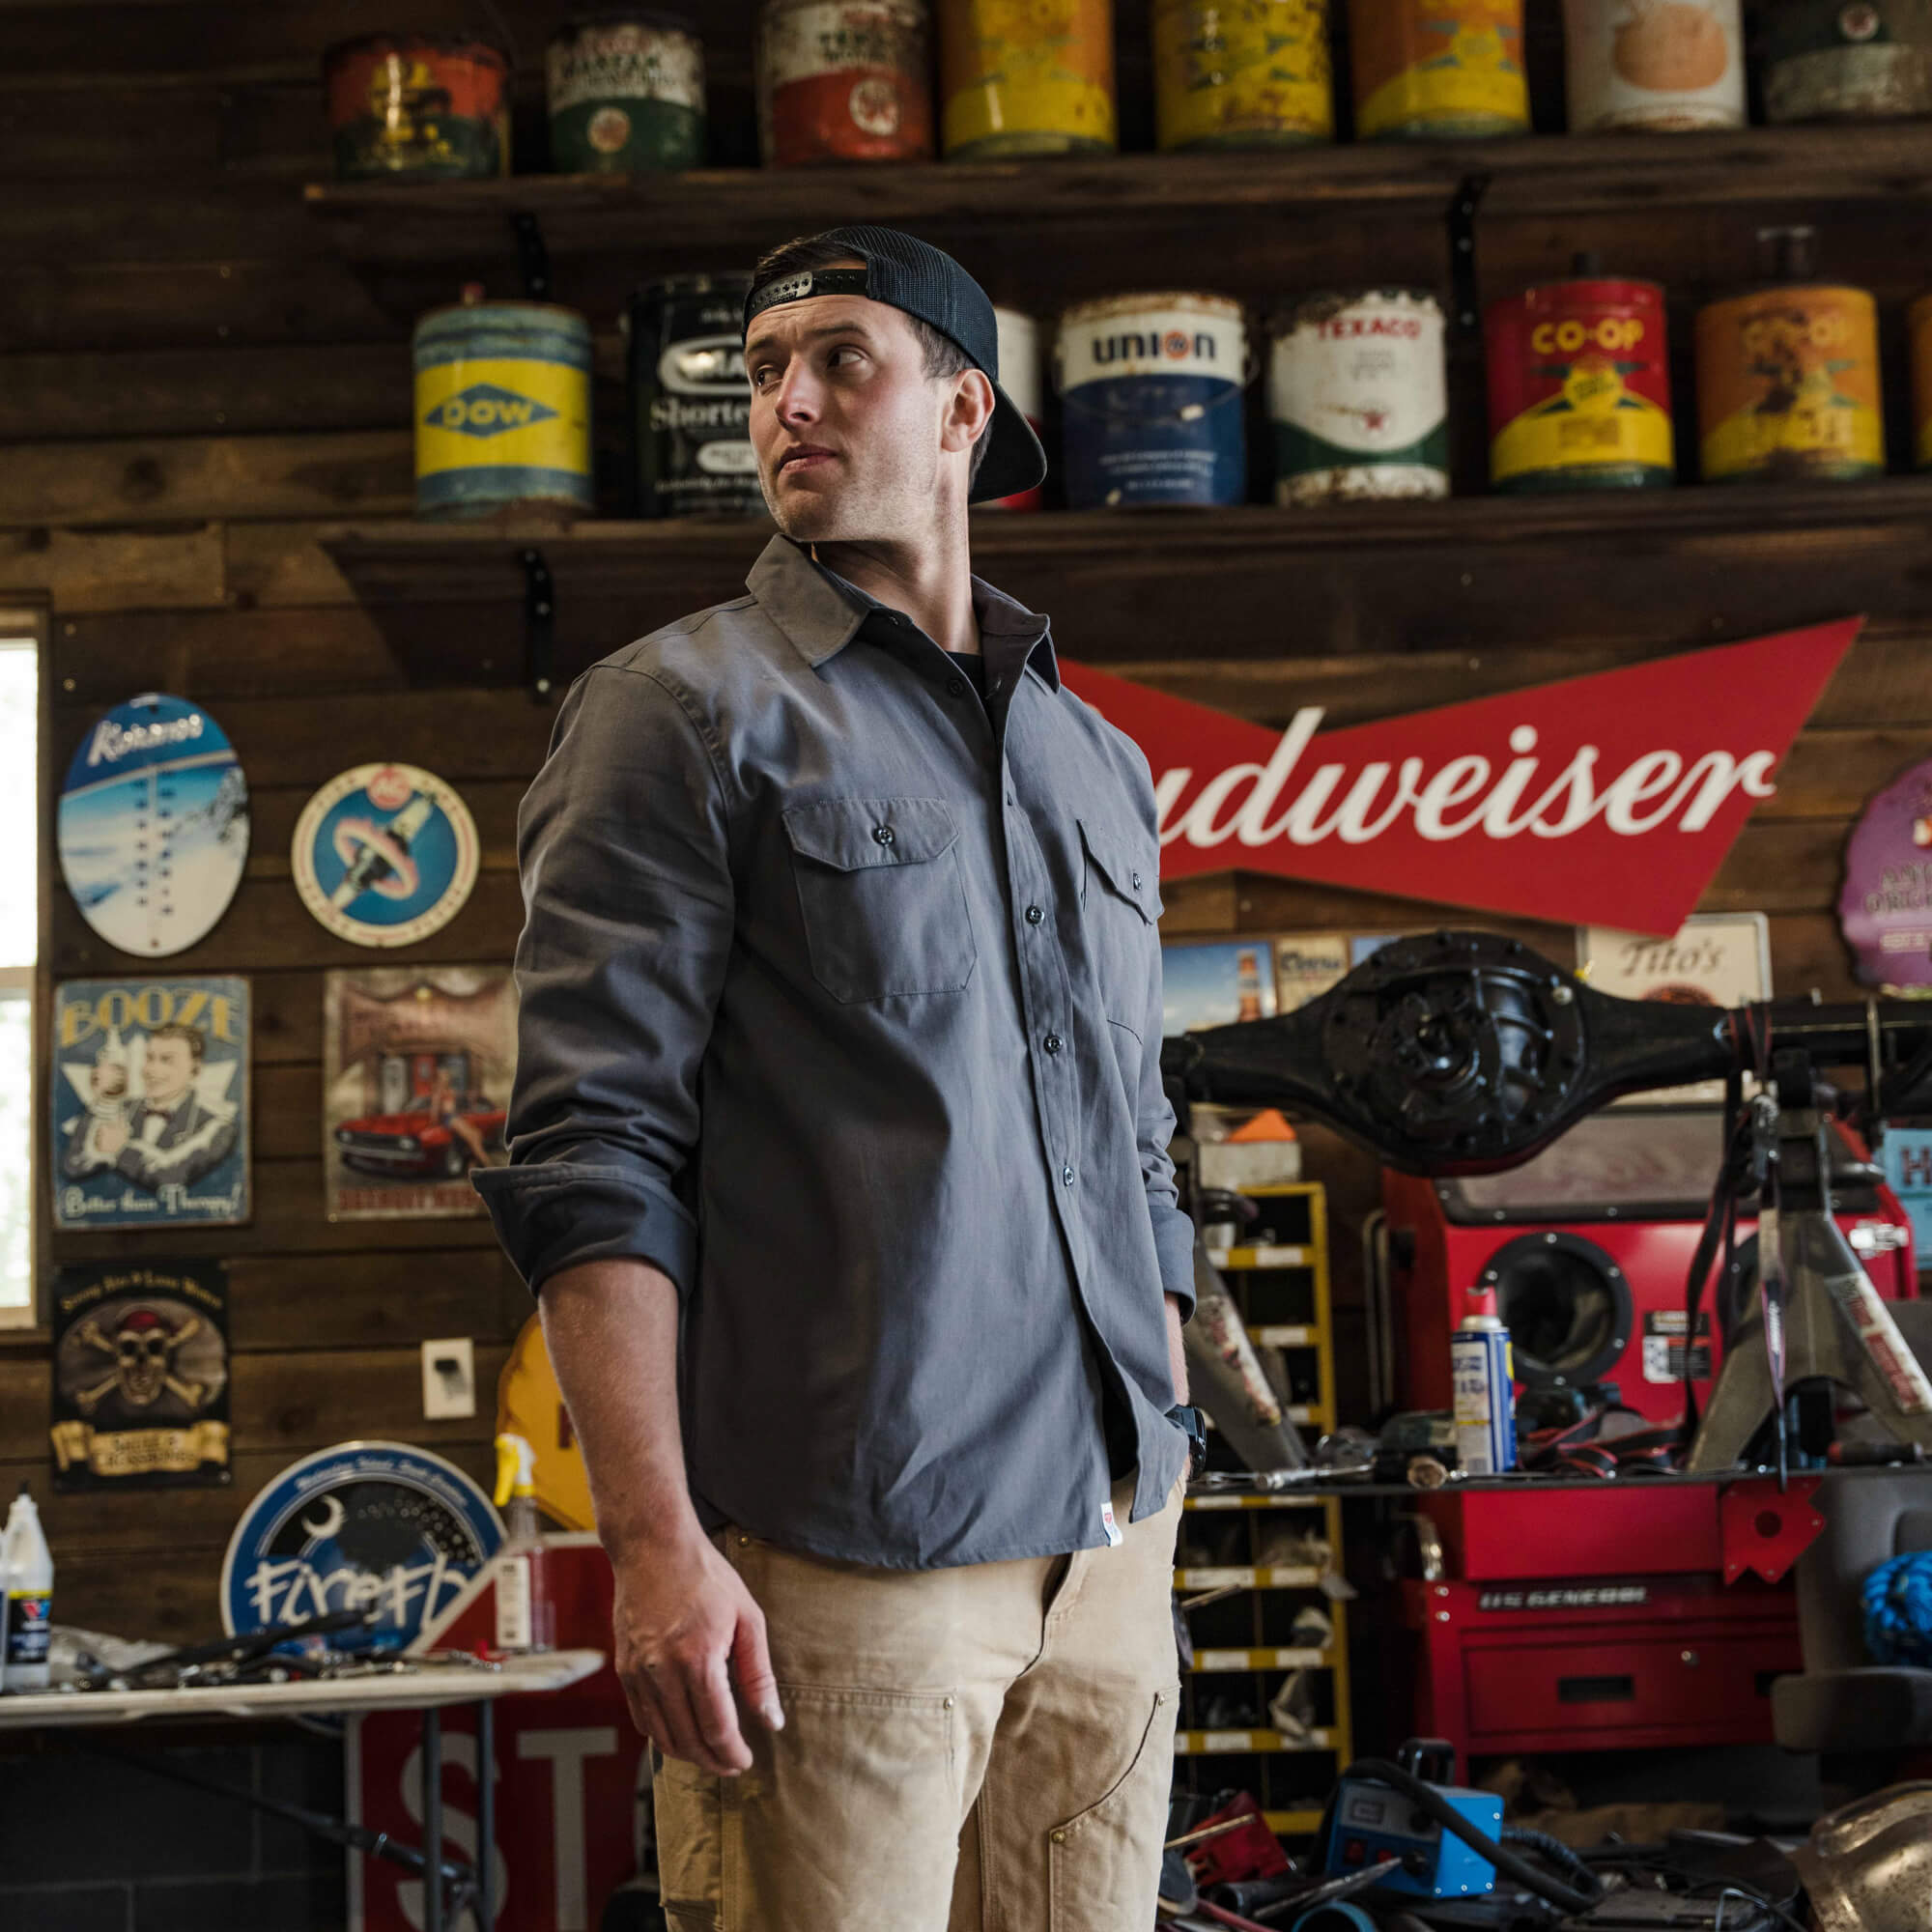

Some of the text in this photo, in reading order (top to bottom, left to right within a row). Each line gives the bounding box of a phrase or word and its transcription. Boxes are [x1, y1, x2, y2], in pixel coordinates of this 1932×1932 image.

[1317, 318, 1421, 341] TEXACO
[1532, 318, 1644, 355] CO-OP
[442, 399, 533, 426] DOW
[1621, 938, 1724, 978] Tito's
[61, 985, 240, 1048] BOOZE
